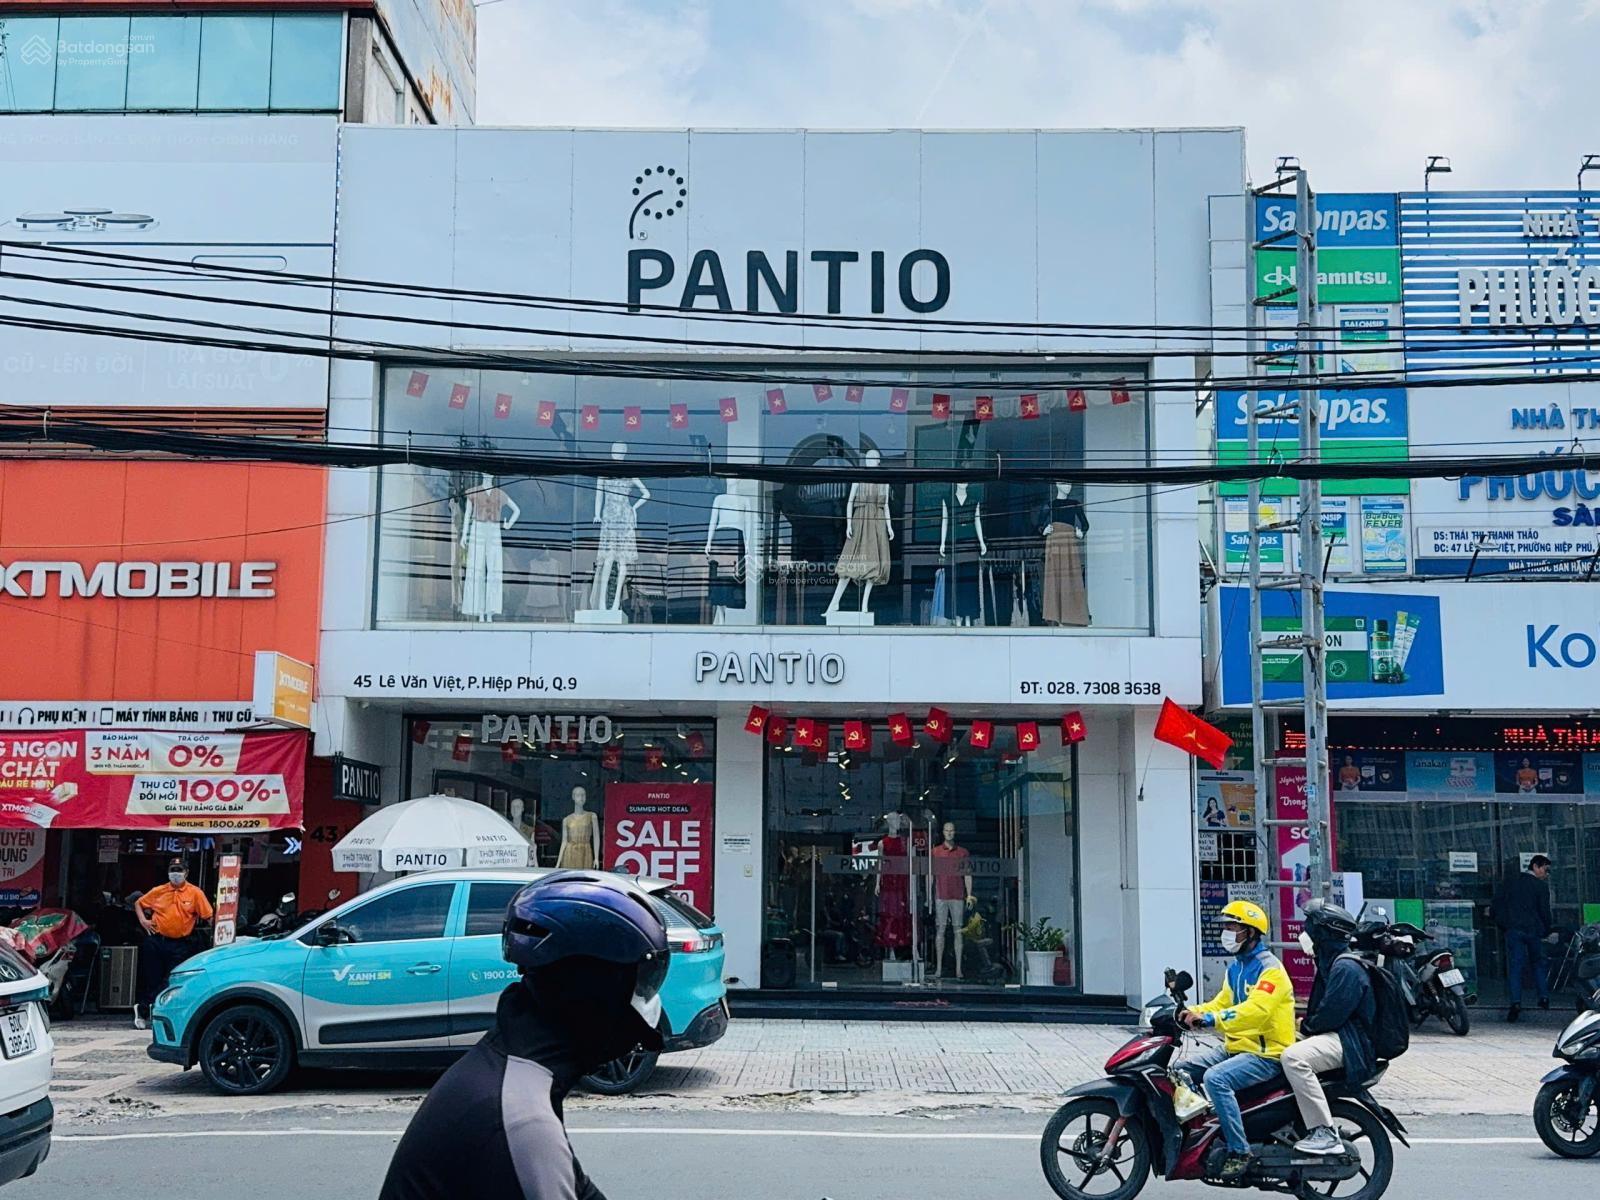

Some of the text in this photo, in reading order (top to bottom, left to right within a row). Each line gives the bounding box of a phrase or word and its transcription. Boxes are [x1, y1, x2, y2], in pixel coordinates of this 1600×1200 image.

[1262, 206, 1388, 236] Sanpas
[1521, 206, 1580, 236] NHÀ
[627, 249, 950, 314] PANTIO
[1511, 403, 1565, 429] NHÀ
[1451, 544, 1462, 553] 47
[696, 651, 845, 684] PANTIO
[353, 675, 372, 688] 45
[379, 675, 396, 689] Lê
[401, 675, 427, 689] Văn
[1020, 681, 1043, 695] ĐT:
[1124, 682, 1161, 695] 3638
[38, 711, 59, 725] PHỤ
[116, 708, 139, 722] MÁY
[142, 708, 167, 722] TÍNH
[169, 707, 198, 722] BẢNG
[212, 710, 231, 722] THU
[236, 708, 252, 722] CŨ
[481, 714, 613, 744] PANTIO
[91, 744, 224, 767] 3 NĂM 0%
[1, 754, 60, 777] CHẤT
[140, 781, 160, 789] THU
[162, 780, 176, 789] CŨ
[342, 764, 380, 799] PANTIO
[158, 792, 178, 801] MỚI
[165, 803, 177, 811] GIÁ
[209, 819, 260, 829] 1800.6229
[310, 825, 338, 843] 43
[475, 834, 507, 842] PANTIO
[615, 819, 701, 848] SALE
[395, 854, 448, 866] PANTIO
[495, 849, 518, 857] TRANG
[614, 850, 700, 885] OFF
[1292, 957, 1311, 966] VIỆT
[348, 972, 376, 981] XANH
[483, 970, 505, 979] 1900
